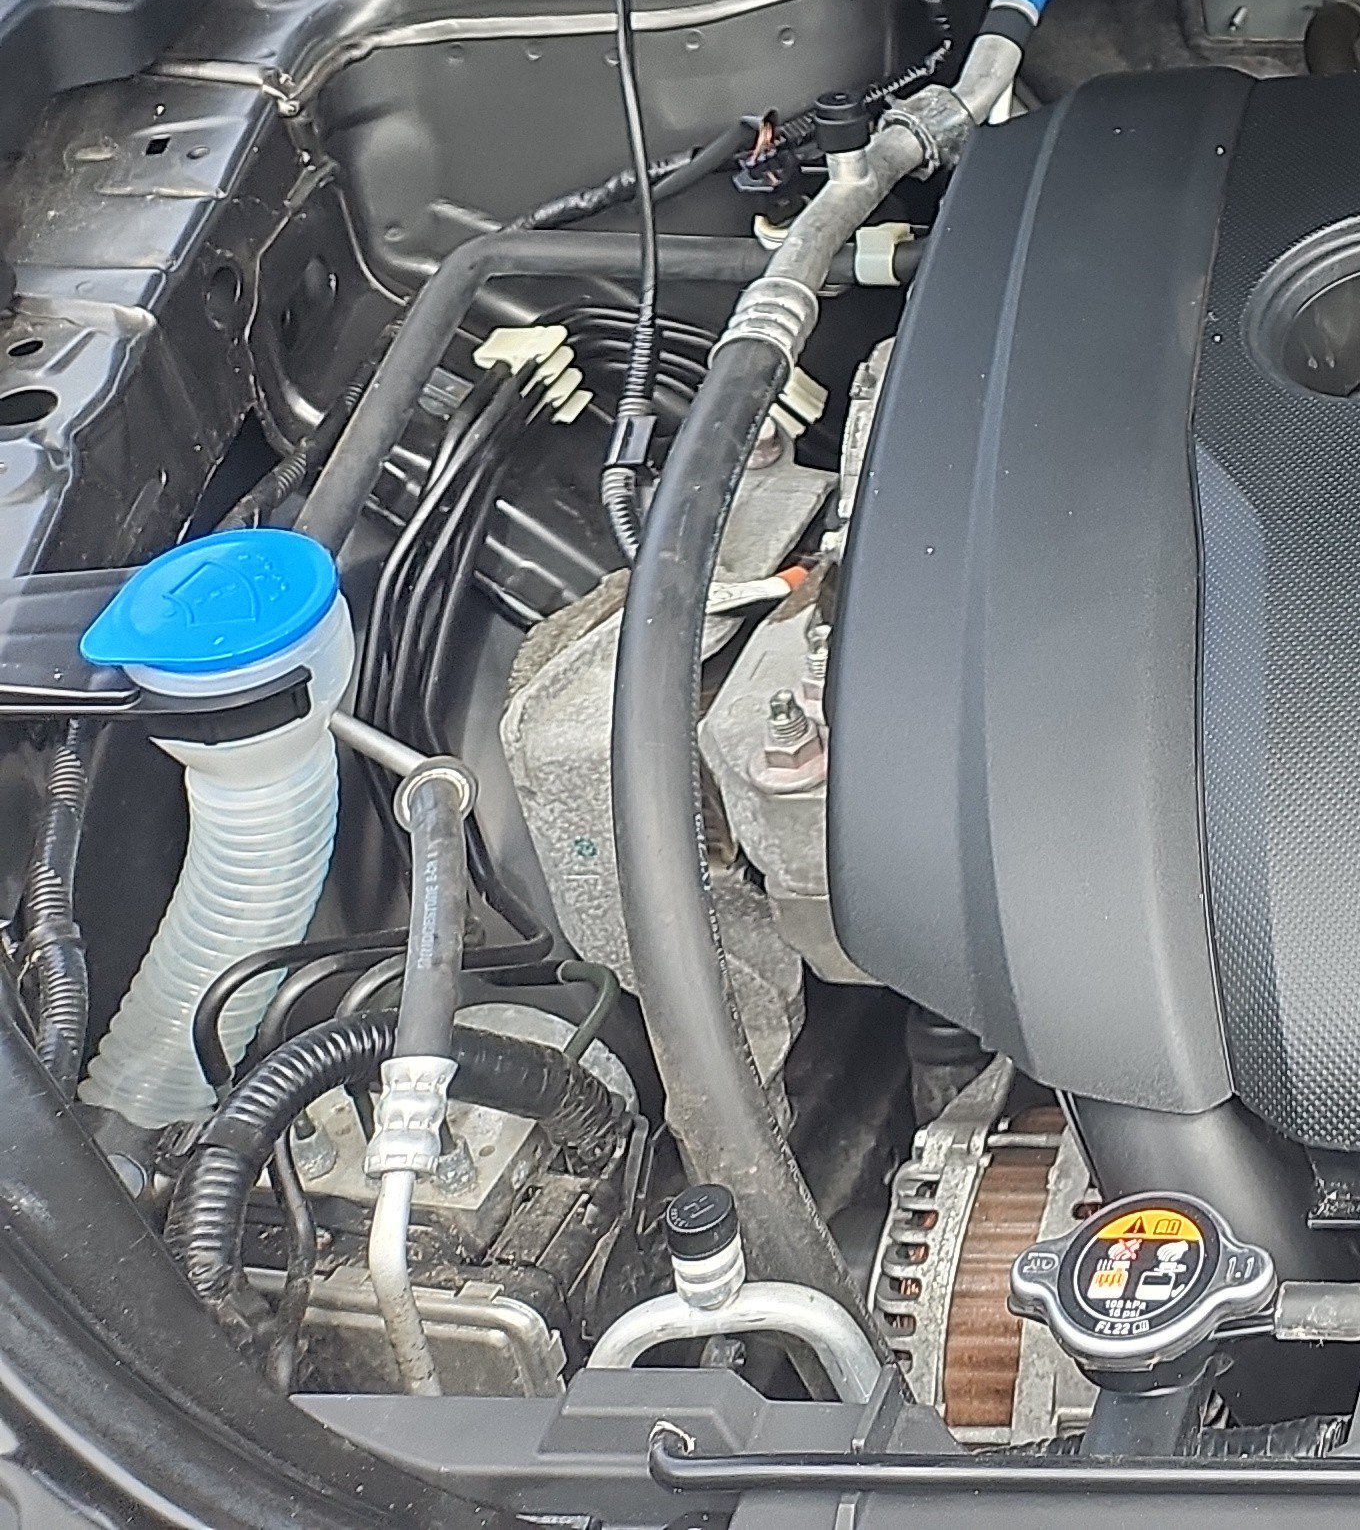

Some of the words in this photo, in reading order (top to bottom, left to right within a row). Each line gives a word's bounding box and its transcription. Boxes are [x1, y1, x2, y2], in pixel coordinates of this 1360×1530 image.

[1124, 1299, 1147, 1310] kPa
[1122, 1308, 1140, 1319] psi
[1094, 1320, 1131, 1335] FL22
